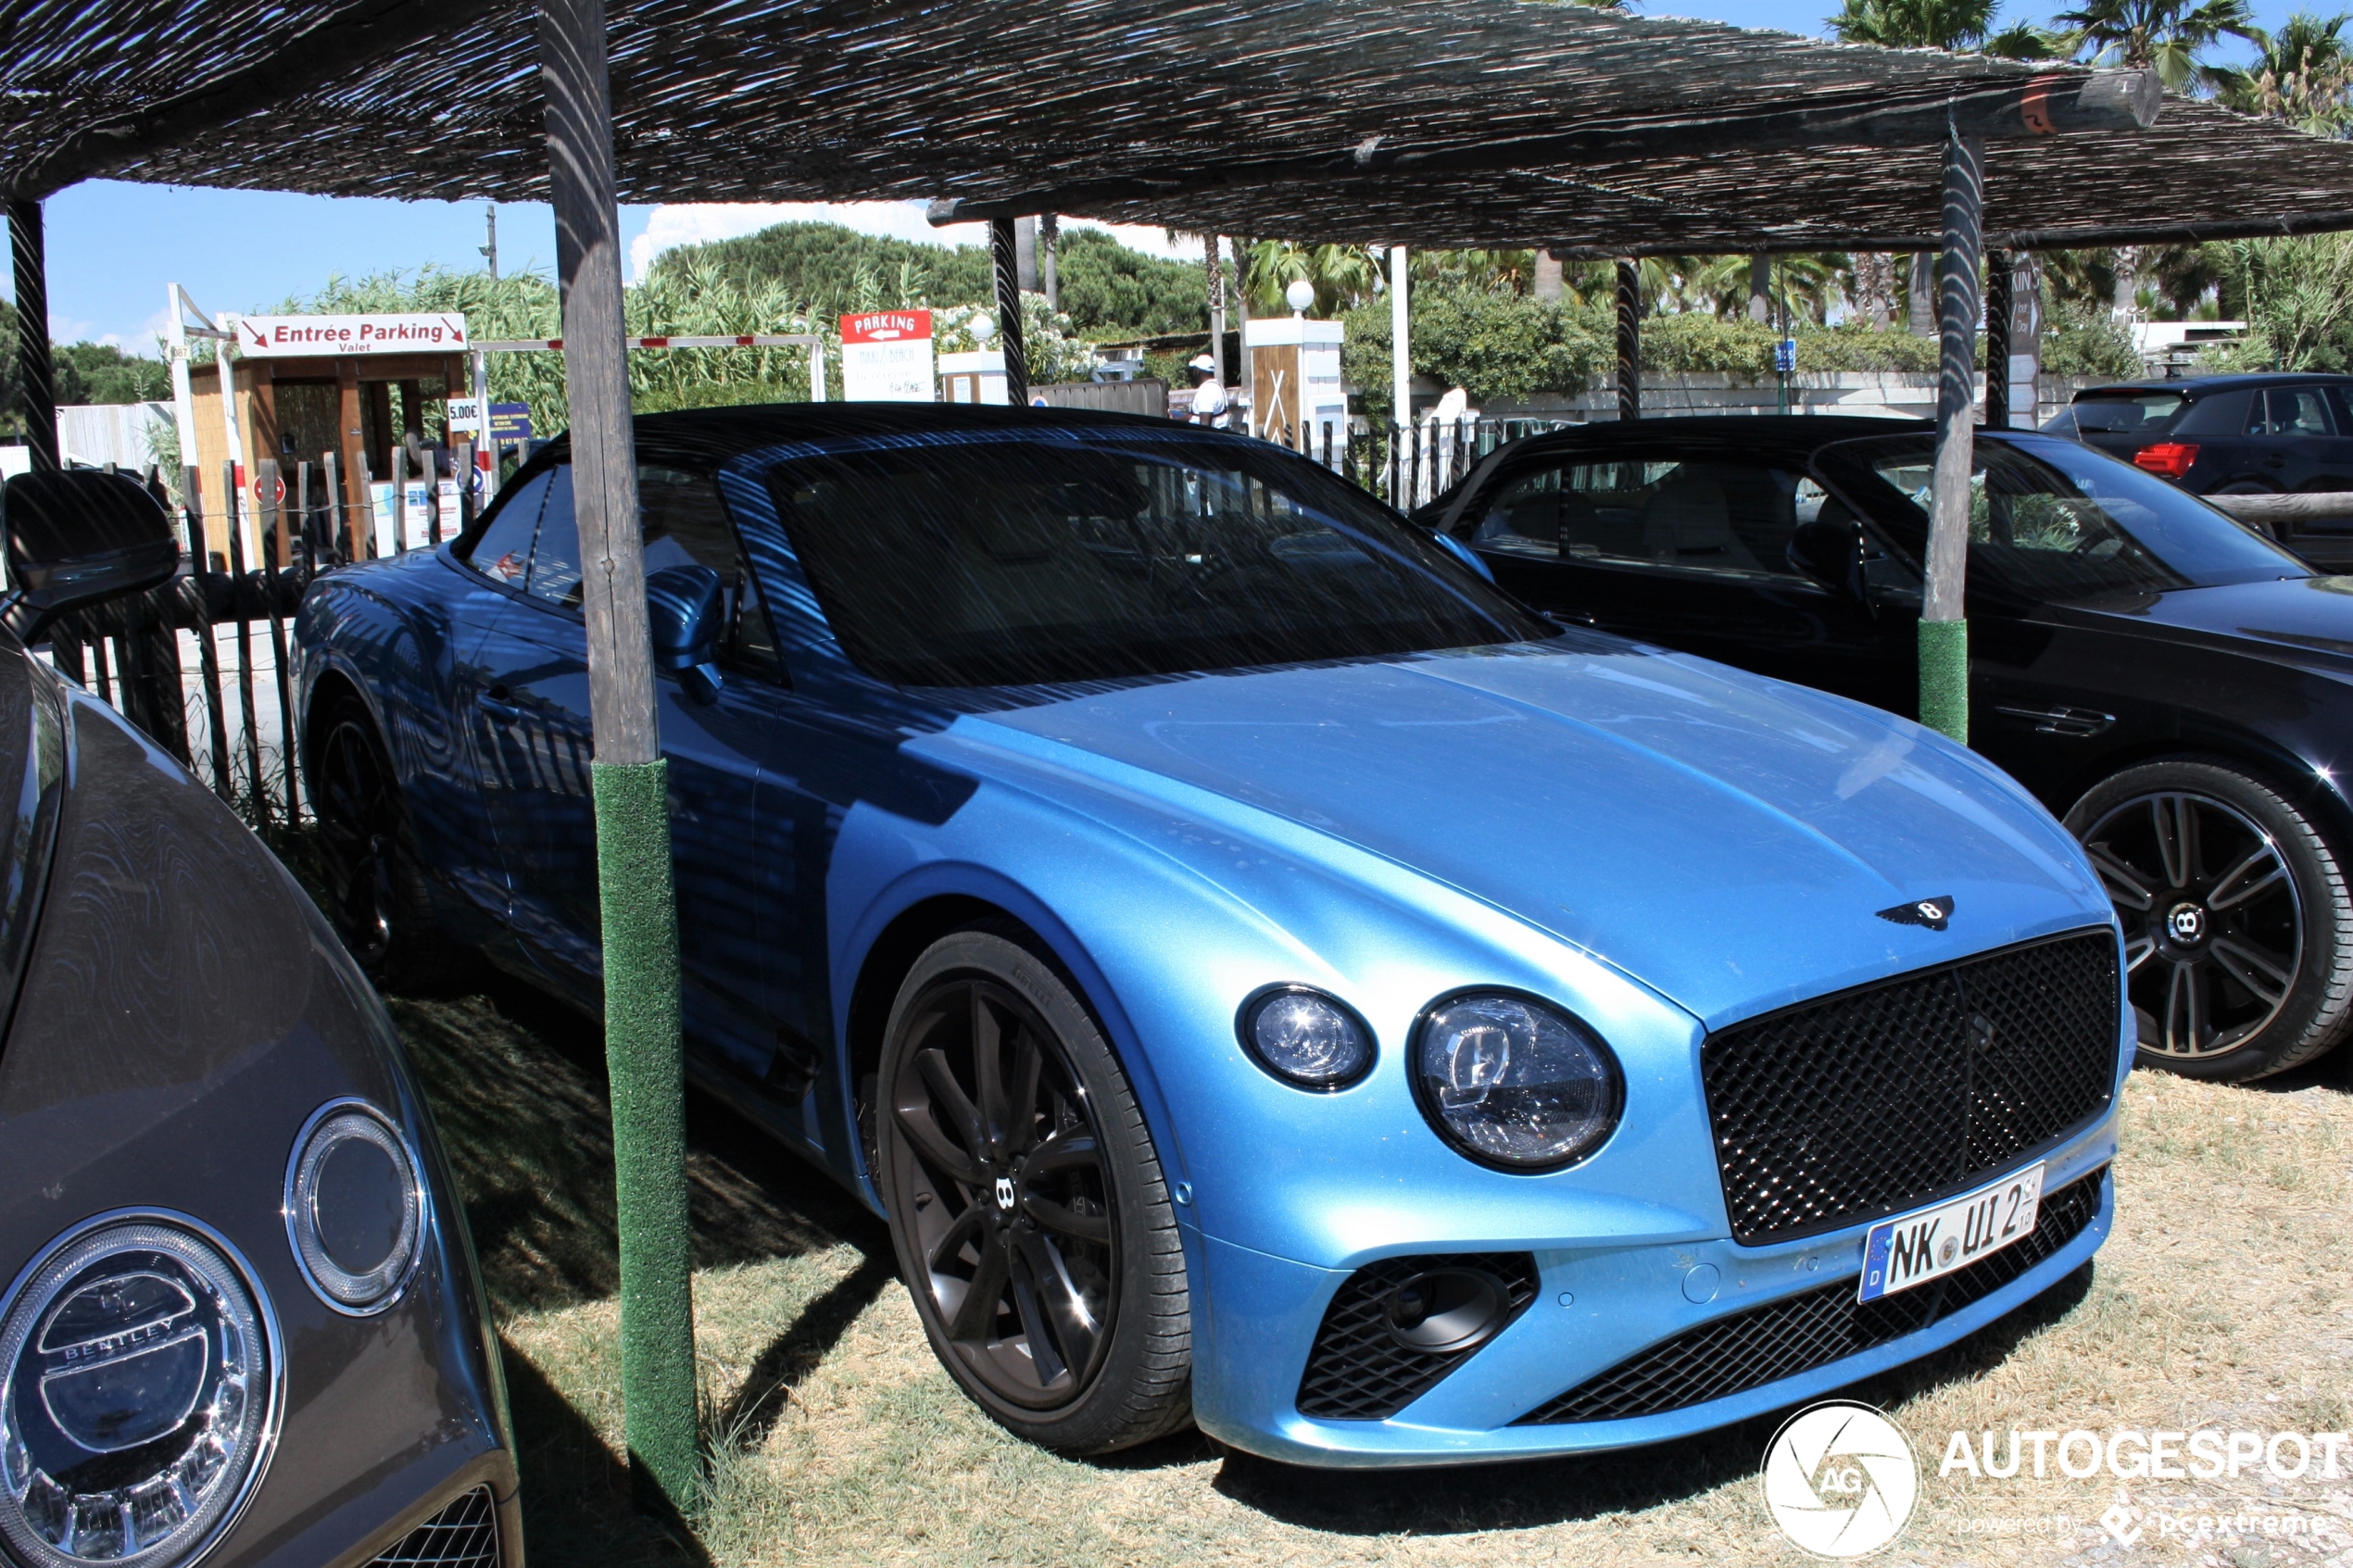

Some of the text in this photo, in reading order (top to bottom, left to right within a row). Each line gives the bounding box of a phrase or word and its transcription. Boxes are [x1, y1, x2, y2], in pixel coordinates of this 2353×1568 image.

[2011, 268, 2040, 292] KING
[274, 323, 443, 343] Entrée Parking
[854, 315, 915, 333] PARKING
[339, 343, 371, 353] Valet
[889, 347, 914, 363] BEACH
[449, 405, 478, 420] 5.00€
[1869, 1183, 2022, 1286] D NK UI 2
[65, 1318, 174, 1361] BENTLEY
